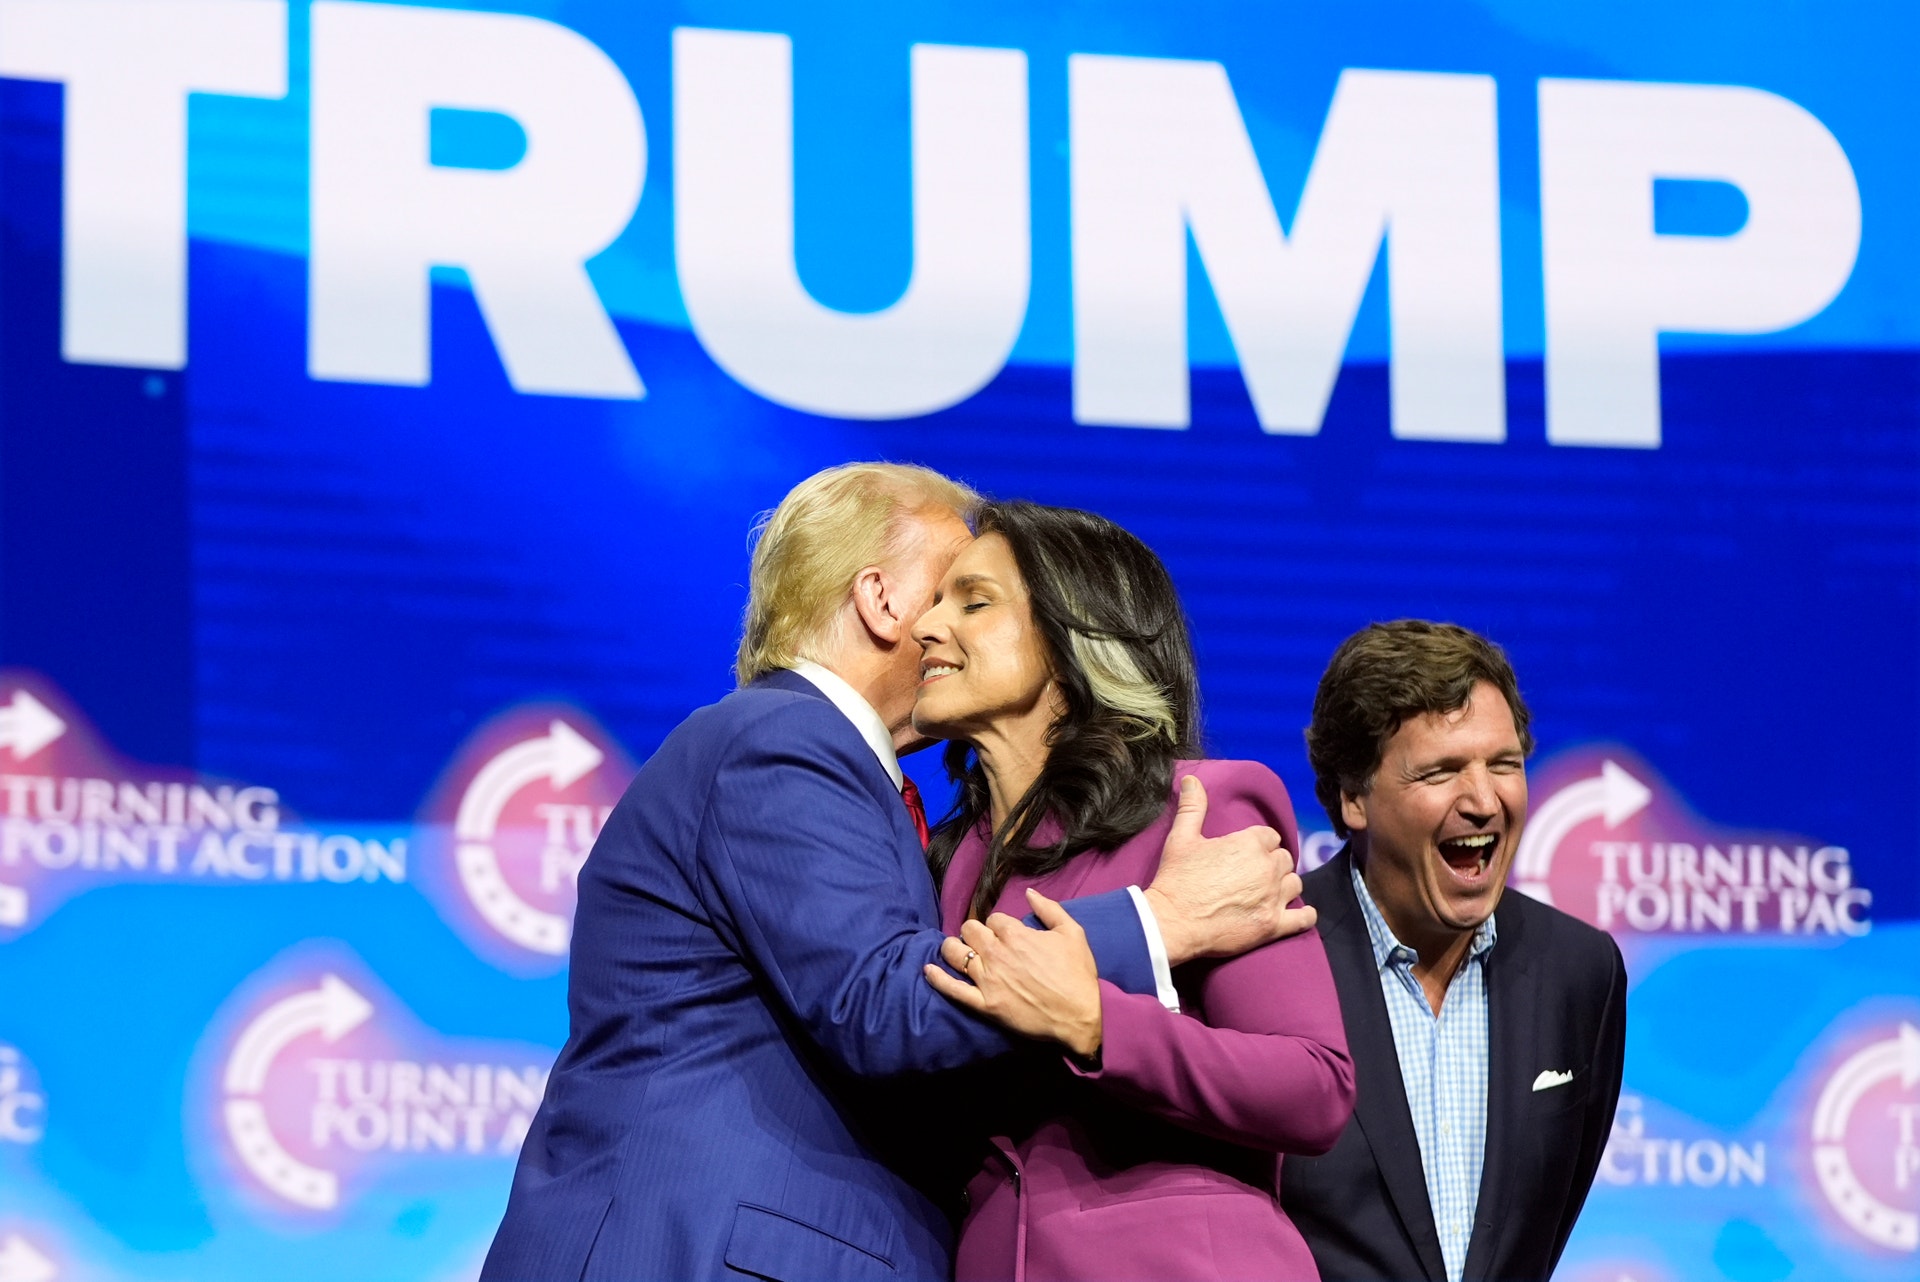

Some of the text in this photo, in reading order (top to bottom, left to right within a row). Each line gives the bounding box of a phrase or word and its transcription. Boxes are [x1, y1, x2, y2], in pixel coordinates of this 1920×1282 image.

[0, 0, 1862, 450] TRUMP
[0, 774, 279, 832] TURNING
[0, 817, 408, 884] POINT ACTION
[1591, 842, 1851, 894] TURNING
[1597, 881, 1873, 937] POINT PAC
[306, 1058, 549, 1110] TURNIN
[312, 1101, 496, 1154] POINT
[1598, 1138, 1766, 1188] CTION
